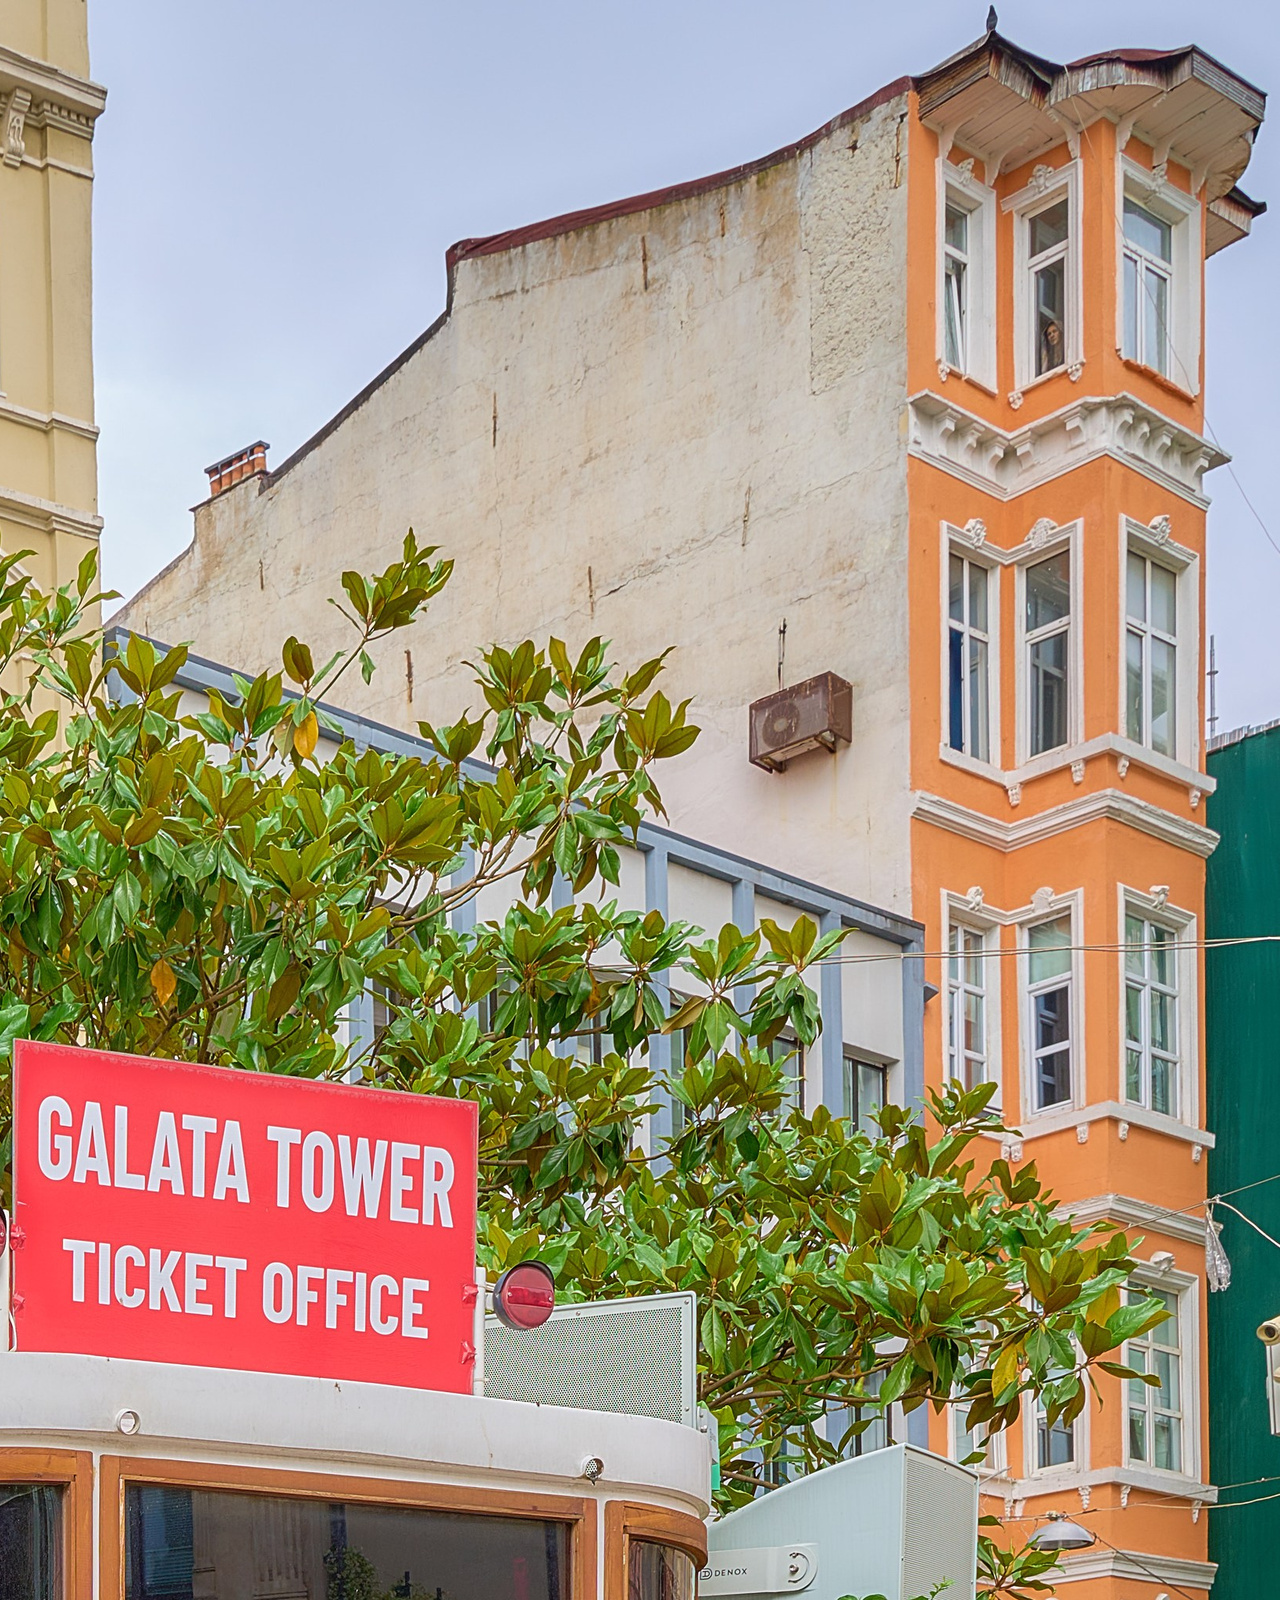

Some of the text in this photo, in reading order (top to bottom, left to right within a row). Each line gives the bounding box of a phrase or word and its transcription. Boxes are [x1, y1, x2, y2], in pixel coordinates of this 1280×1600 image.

[37, 1095, 455, 1229] GALATA TOWER
[62, 1238, 429, 1340] TICKET OFFICE
[714, 1568, 748, 1577] DENOX
